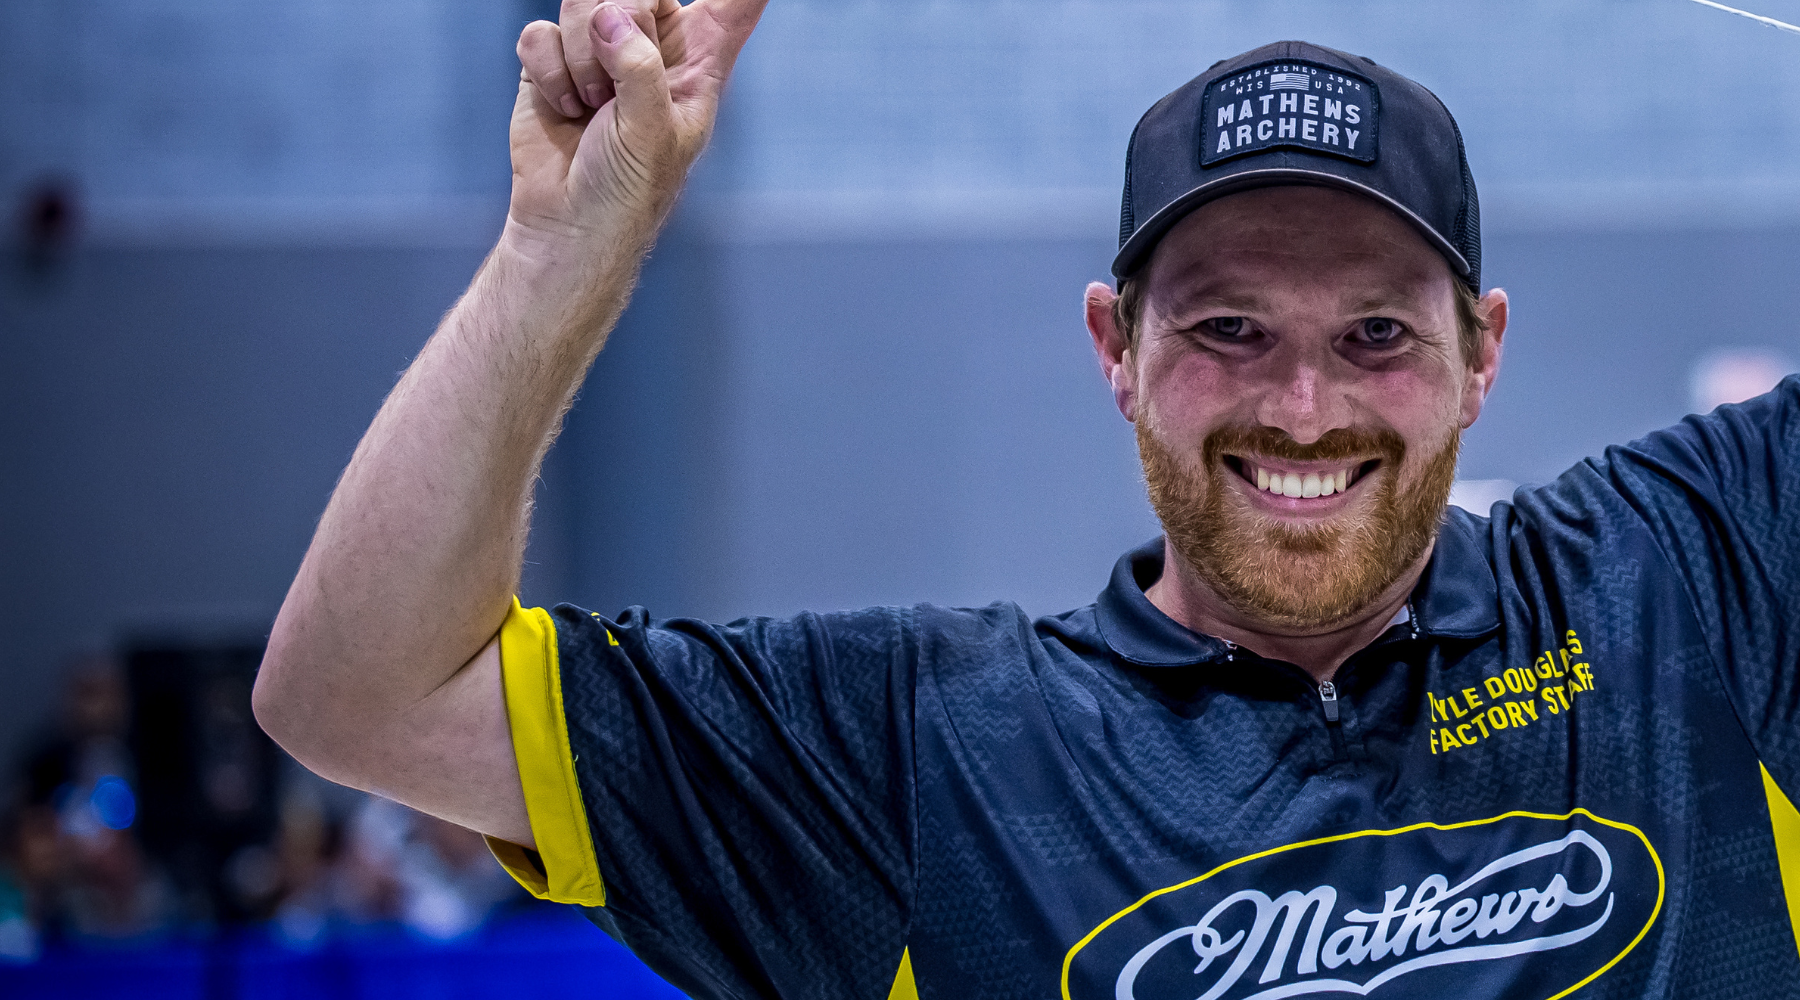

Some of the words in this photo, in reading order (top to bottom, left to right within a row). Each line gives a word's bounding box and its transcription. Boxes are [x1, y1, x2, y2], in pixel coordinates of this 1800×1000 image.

[1220, 65, 1317, 92] ESTABLISHED
[1328, 73, 1361, 91] 1992
[1235, 81, 1264, 95] WIS
[1314, 81, 1344, 94] USA
[1217, 93, 1361, 128] MATHEWS
[1216, 117, 1360, 153] ARCHERY
[1430, 699, 1539, 755] FACTORY
[1540, 662, 1595, 715] STAFF
[1130, 832, 1612, 998] Mathews
